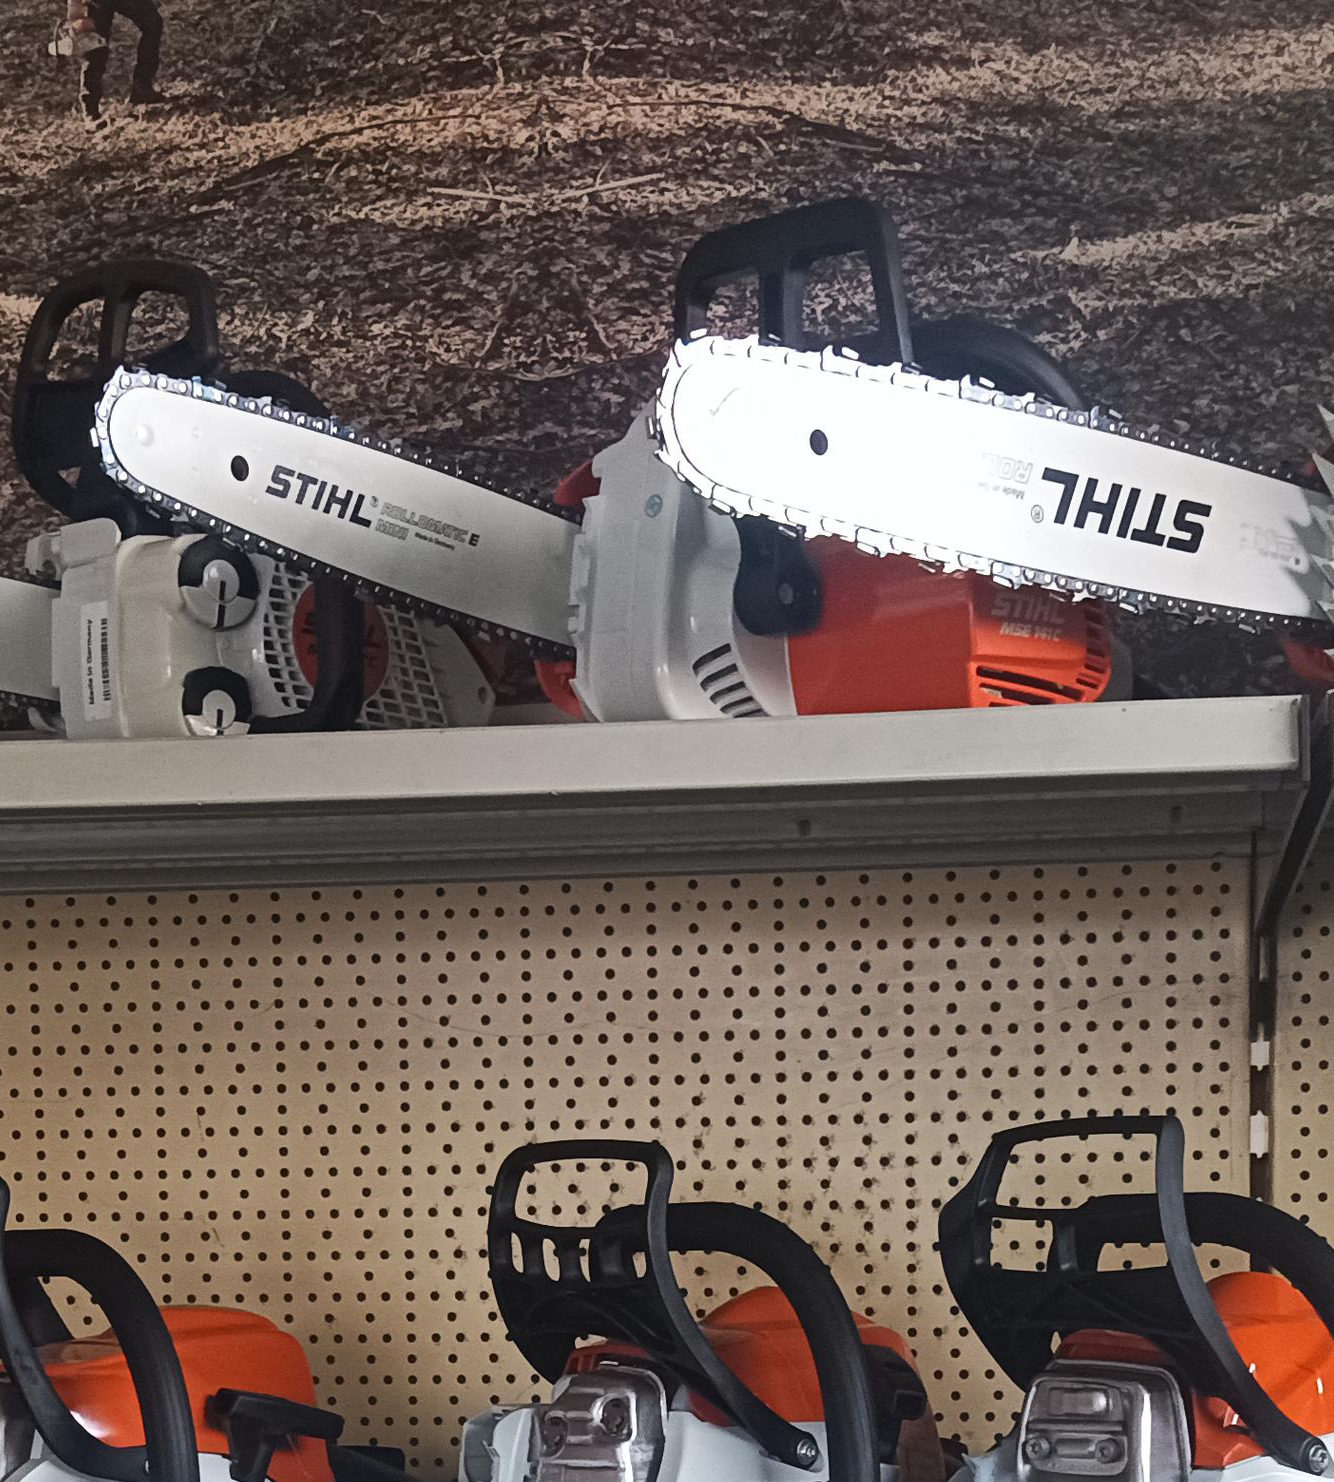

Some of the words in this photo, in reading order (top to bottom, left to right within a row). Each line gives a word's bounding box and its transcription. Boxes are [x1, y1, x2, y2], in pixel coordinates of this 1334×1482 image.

[265, 464, 371, 528] STIHL
[468, 533, 480, 547] E
[1041, 466, 1212, 553] STIHL
[990, 592, 1066, 624] STIHL
